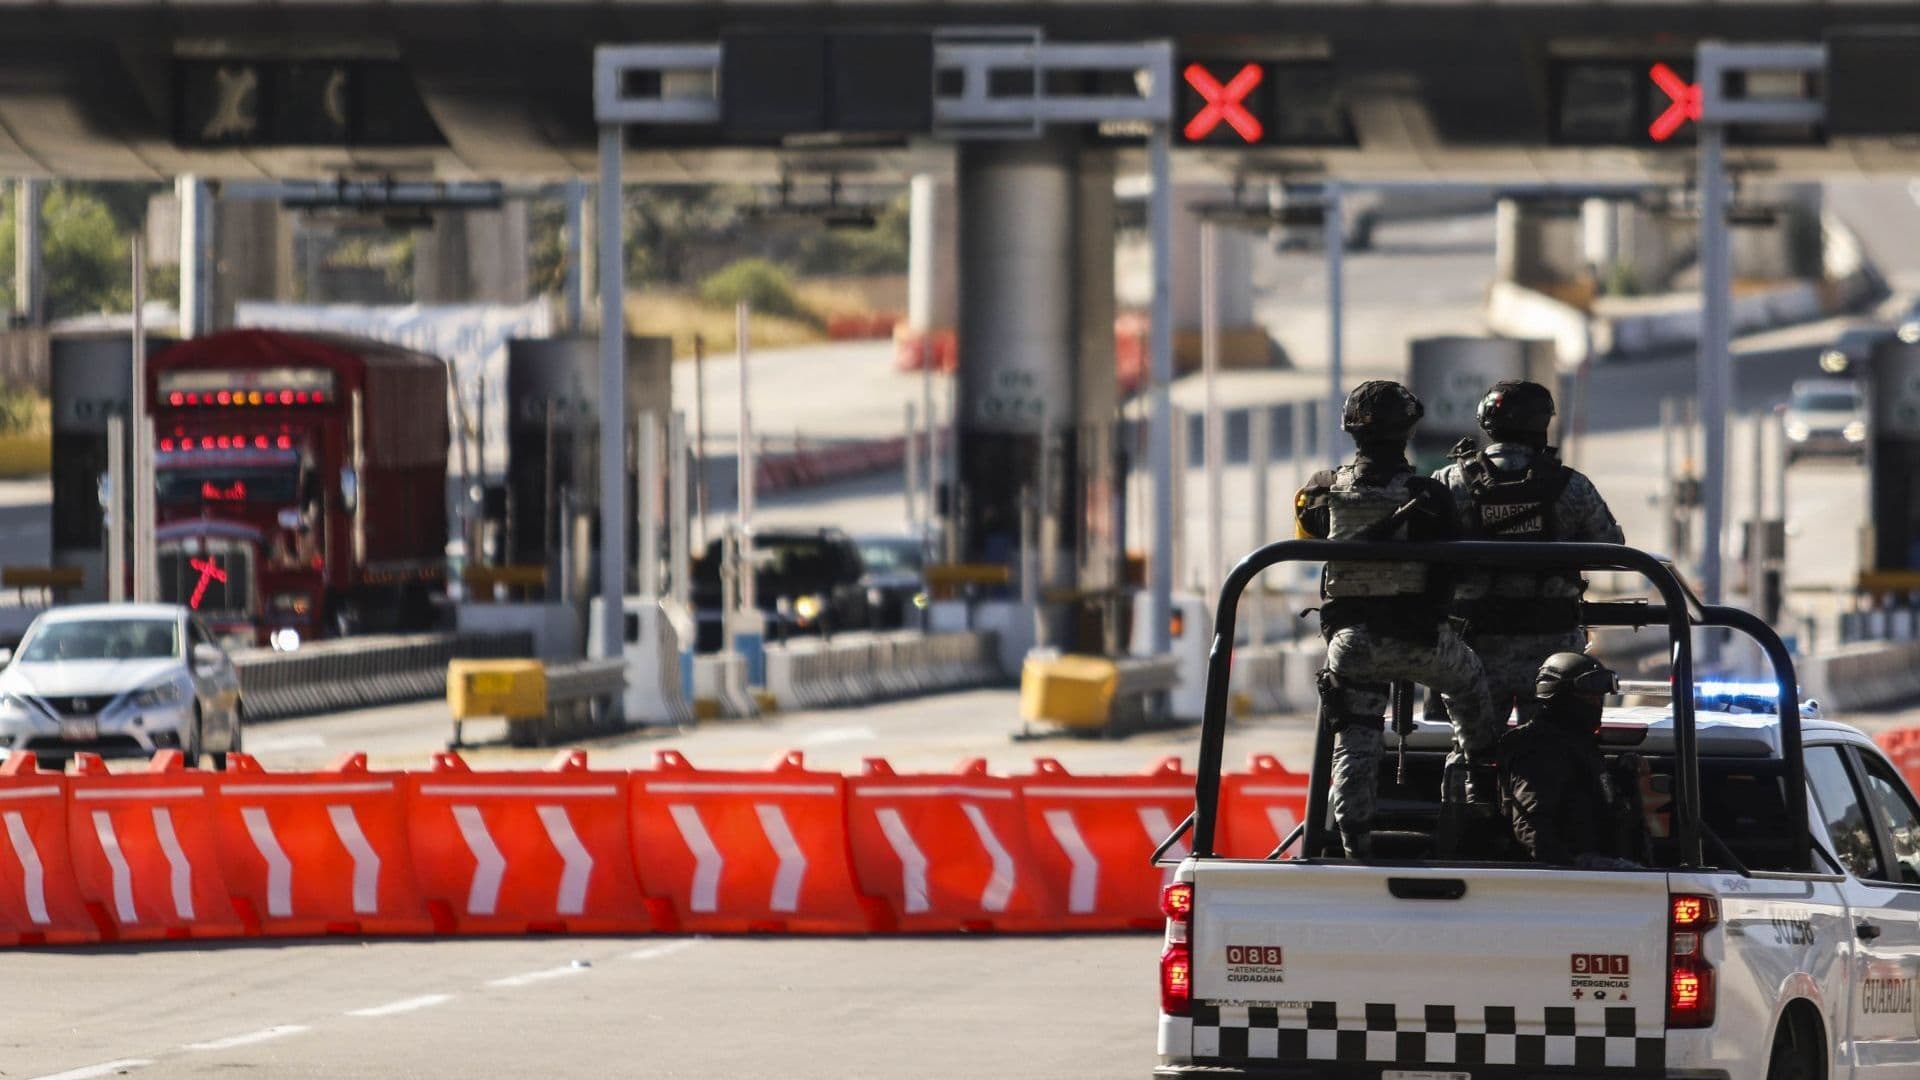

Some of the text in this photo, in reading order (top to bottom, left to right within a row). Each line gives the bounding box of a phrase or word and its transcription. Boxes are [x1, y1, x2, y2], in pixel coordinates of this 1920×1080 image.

[1229, 948, 1279, 963] 088
[1574, 957, 1624, 972] 911
[1227, 974, 1284, 983] CIUDADANA
[1571, 980, 1629, 988] EMERGENCIAS
[1863, 978, 1912, 1014] GUARDIA
